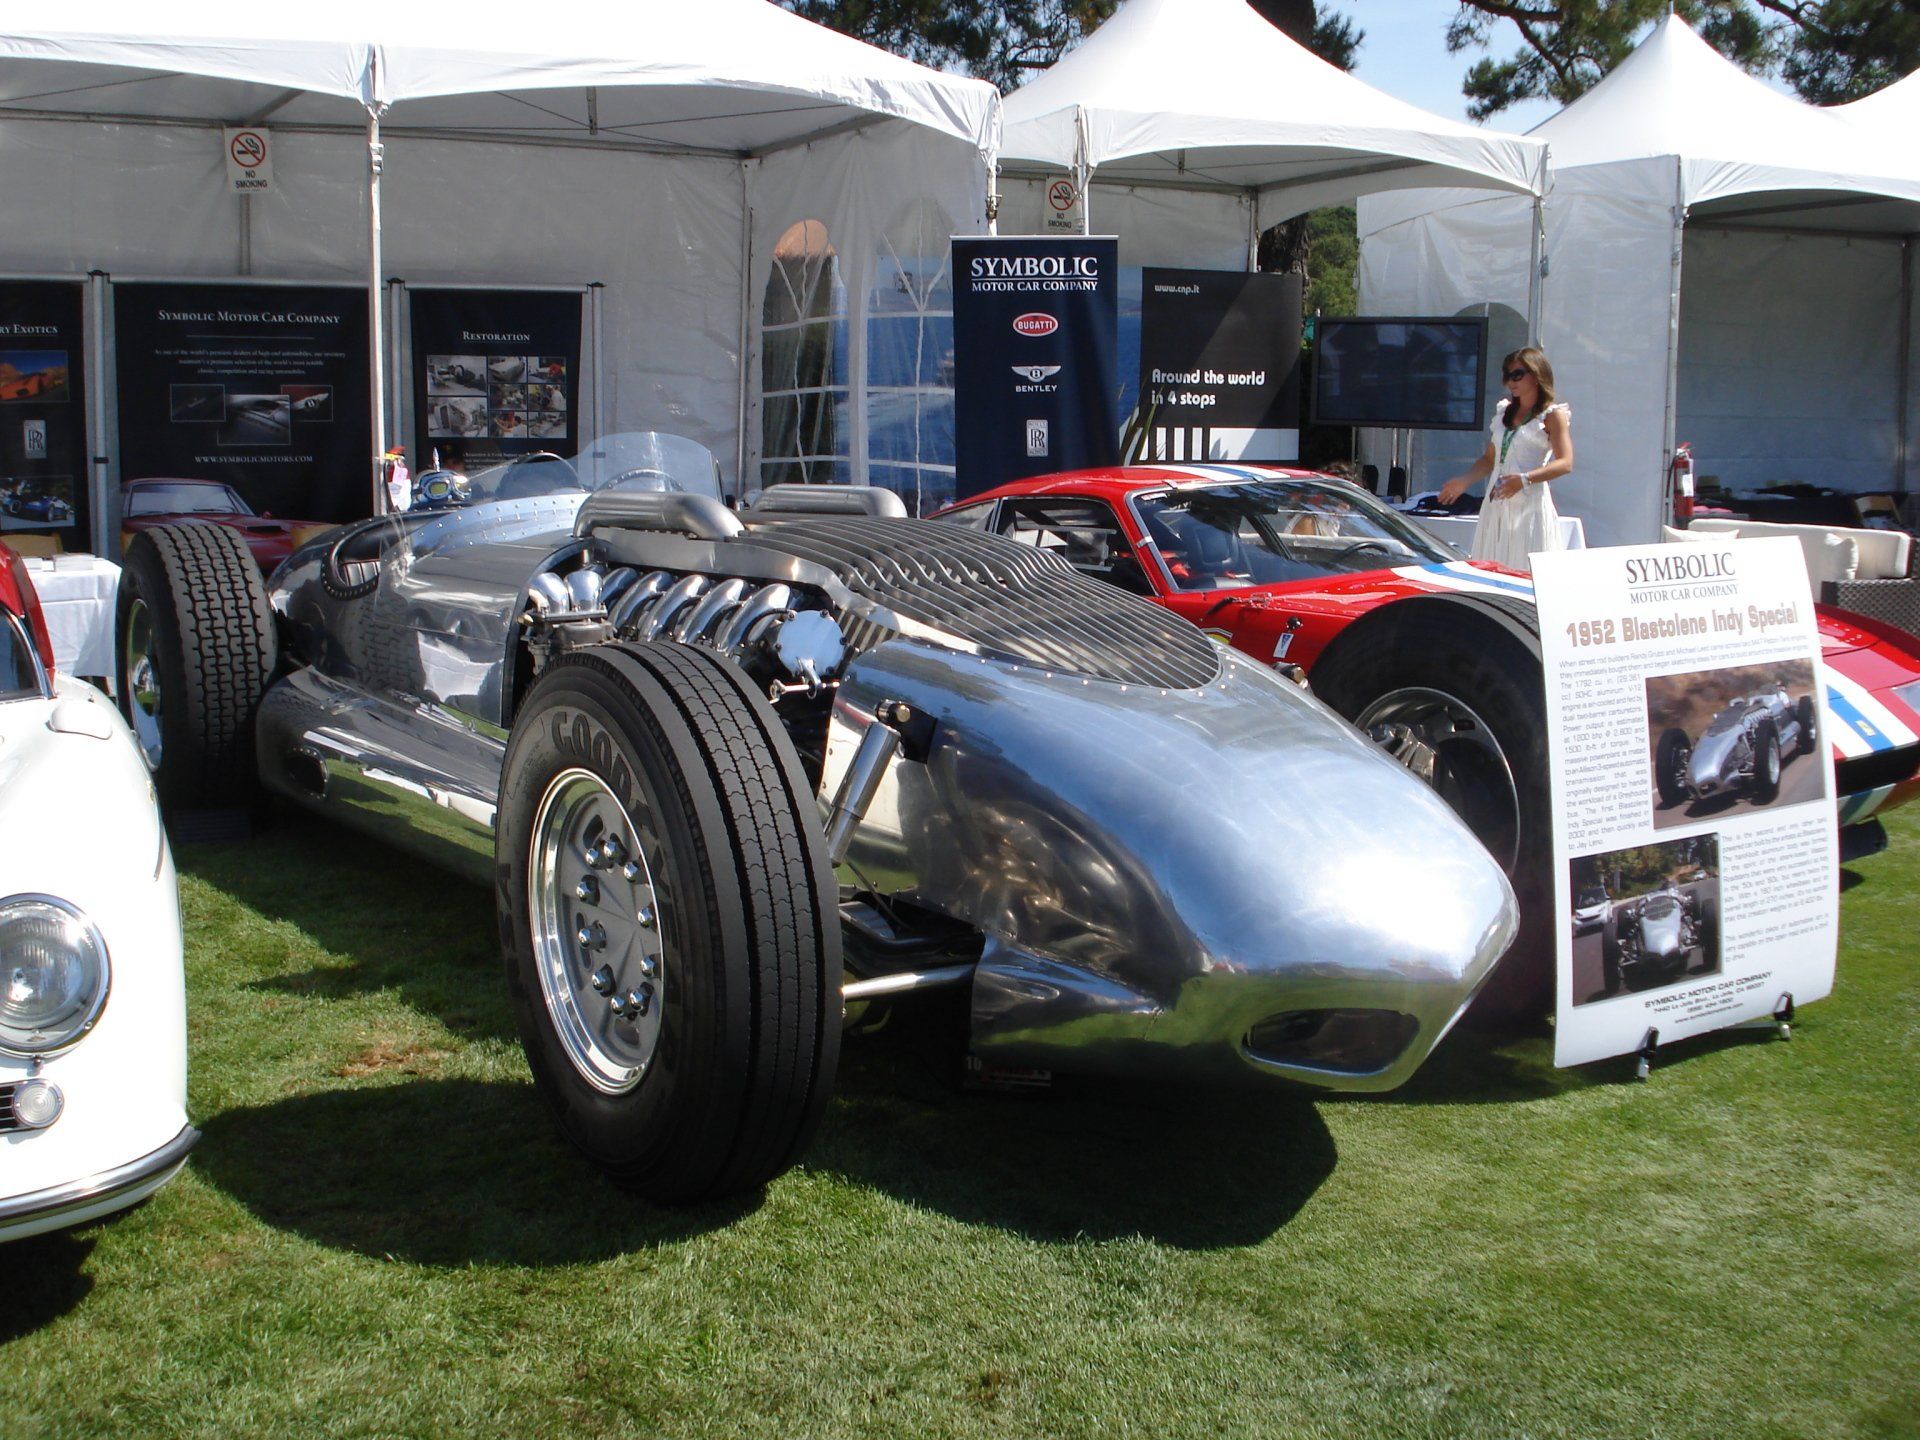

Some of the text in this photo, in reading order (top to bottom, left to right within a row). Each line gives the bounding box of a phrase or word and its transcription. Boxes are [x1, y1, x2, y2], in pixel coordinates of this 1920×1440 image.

[245, 170, 256, 179] NO
[235, 179, 268, 189] SMOKING
[1047, 219, 1072, 229] SMOKING
[971, 256, 1098, 277] SYMBOLIC
[972, 280, 1098, 292] MOTOR CAR COMPANY
[1154, 284, 1200, 295] www.cnp.it
[1018, 321, 1053, 330] BUGATTI
[1152, 368, 1265, 386] Around the world
[1015, 385, 1058, 393] BENTLEY
[1151, 390, 1216, 409] in 4 stops
[1626, 552, 1737, 584] SYMBOLIC
[1630, 583, 1739, 604] MOTOR CAR COMPANY
[1566, 600, 1799, 648] 1952 Blastolene Indy Special
[1645, 970, 1772, 1009] SYMBOLIC MOTOR CAR COMPANY
